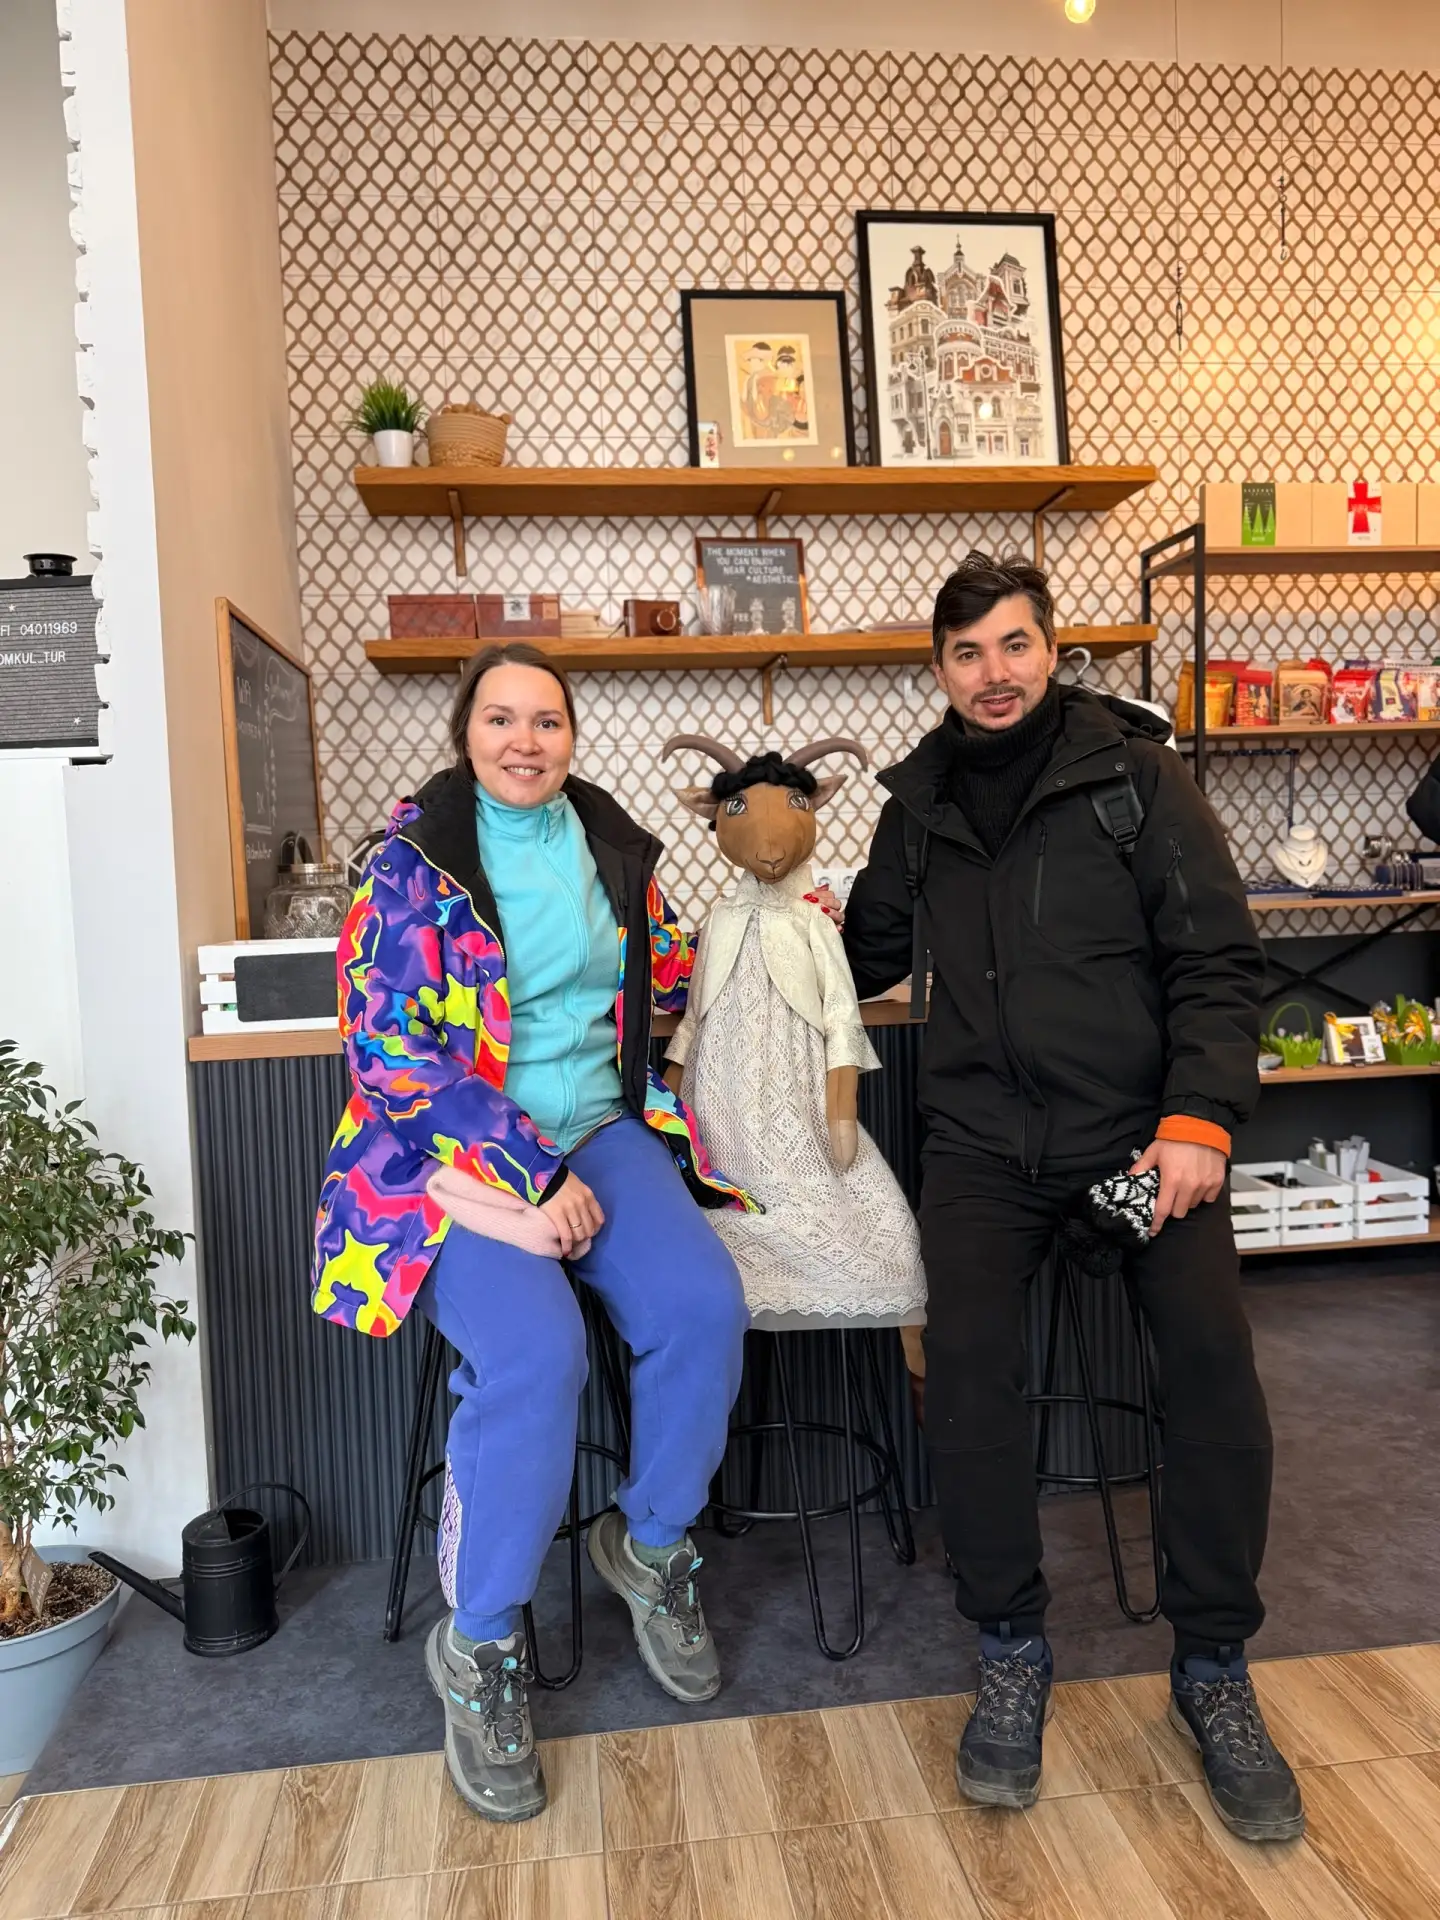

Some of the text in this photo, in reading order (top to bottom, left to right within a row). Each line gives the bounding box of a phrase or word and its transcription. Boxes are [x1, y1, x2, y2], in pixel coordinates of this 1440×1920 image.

[706, 548, 786, 557] THE MOMENT WHEN
[716, 557, 730, 565] YOU
[734, 557, 750, 565] CAN
[723, 566, 784, 575] NEAR CULTURE
[20, 621, 78, 637] 04011969
